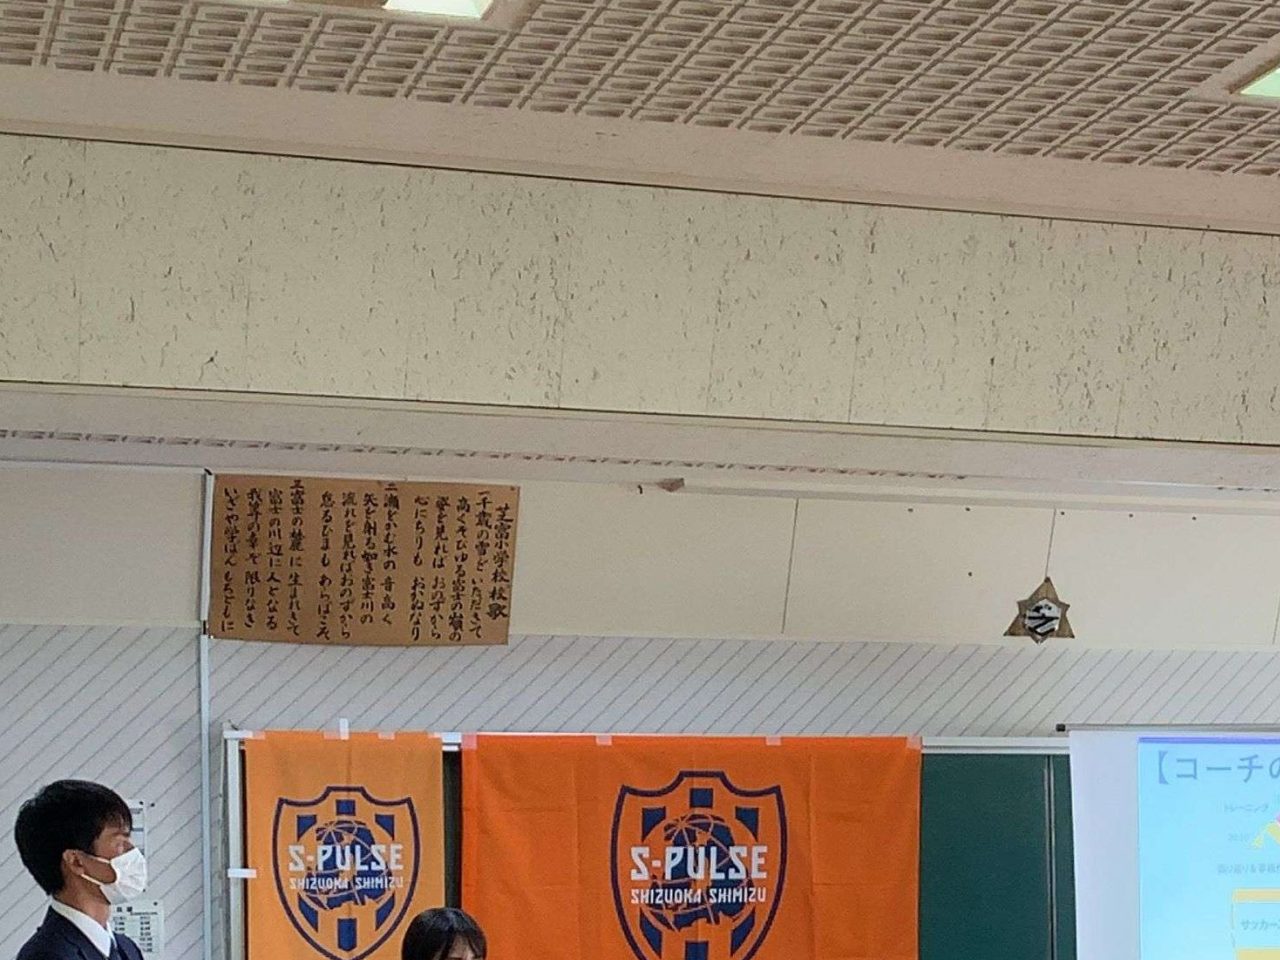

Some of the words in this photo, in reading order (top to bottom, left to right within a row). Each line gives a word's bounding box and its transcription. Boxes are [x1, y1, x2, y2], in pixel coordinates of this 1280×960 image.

[288, 843, 404, 872] S-PULSE
[630, 845, 768, 881] S-PULSE
[289, 876, 349, 890] SHIZUOKA
[355, 875, 404, 889] SHIMIZU
[630, 888, 702, 905] SHIZUOKA
[709, 887, 767, 904] SHIMIZU
